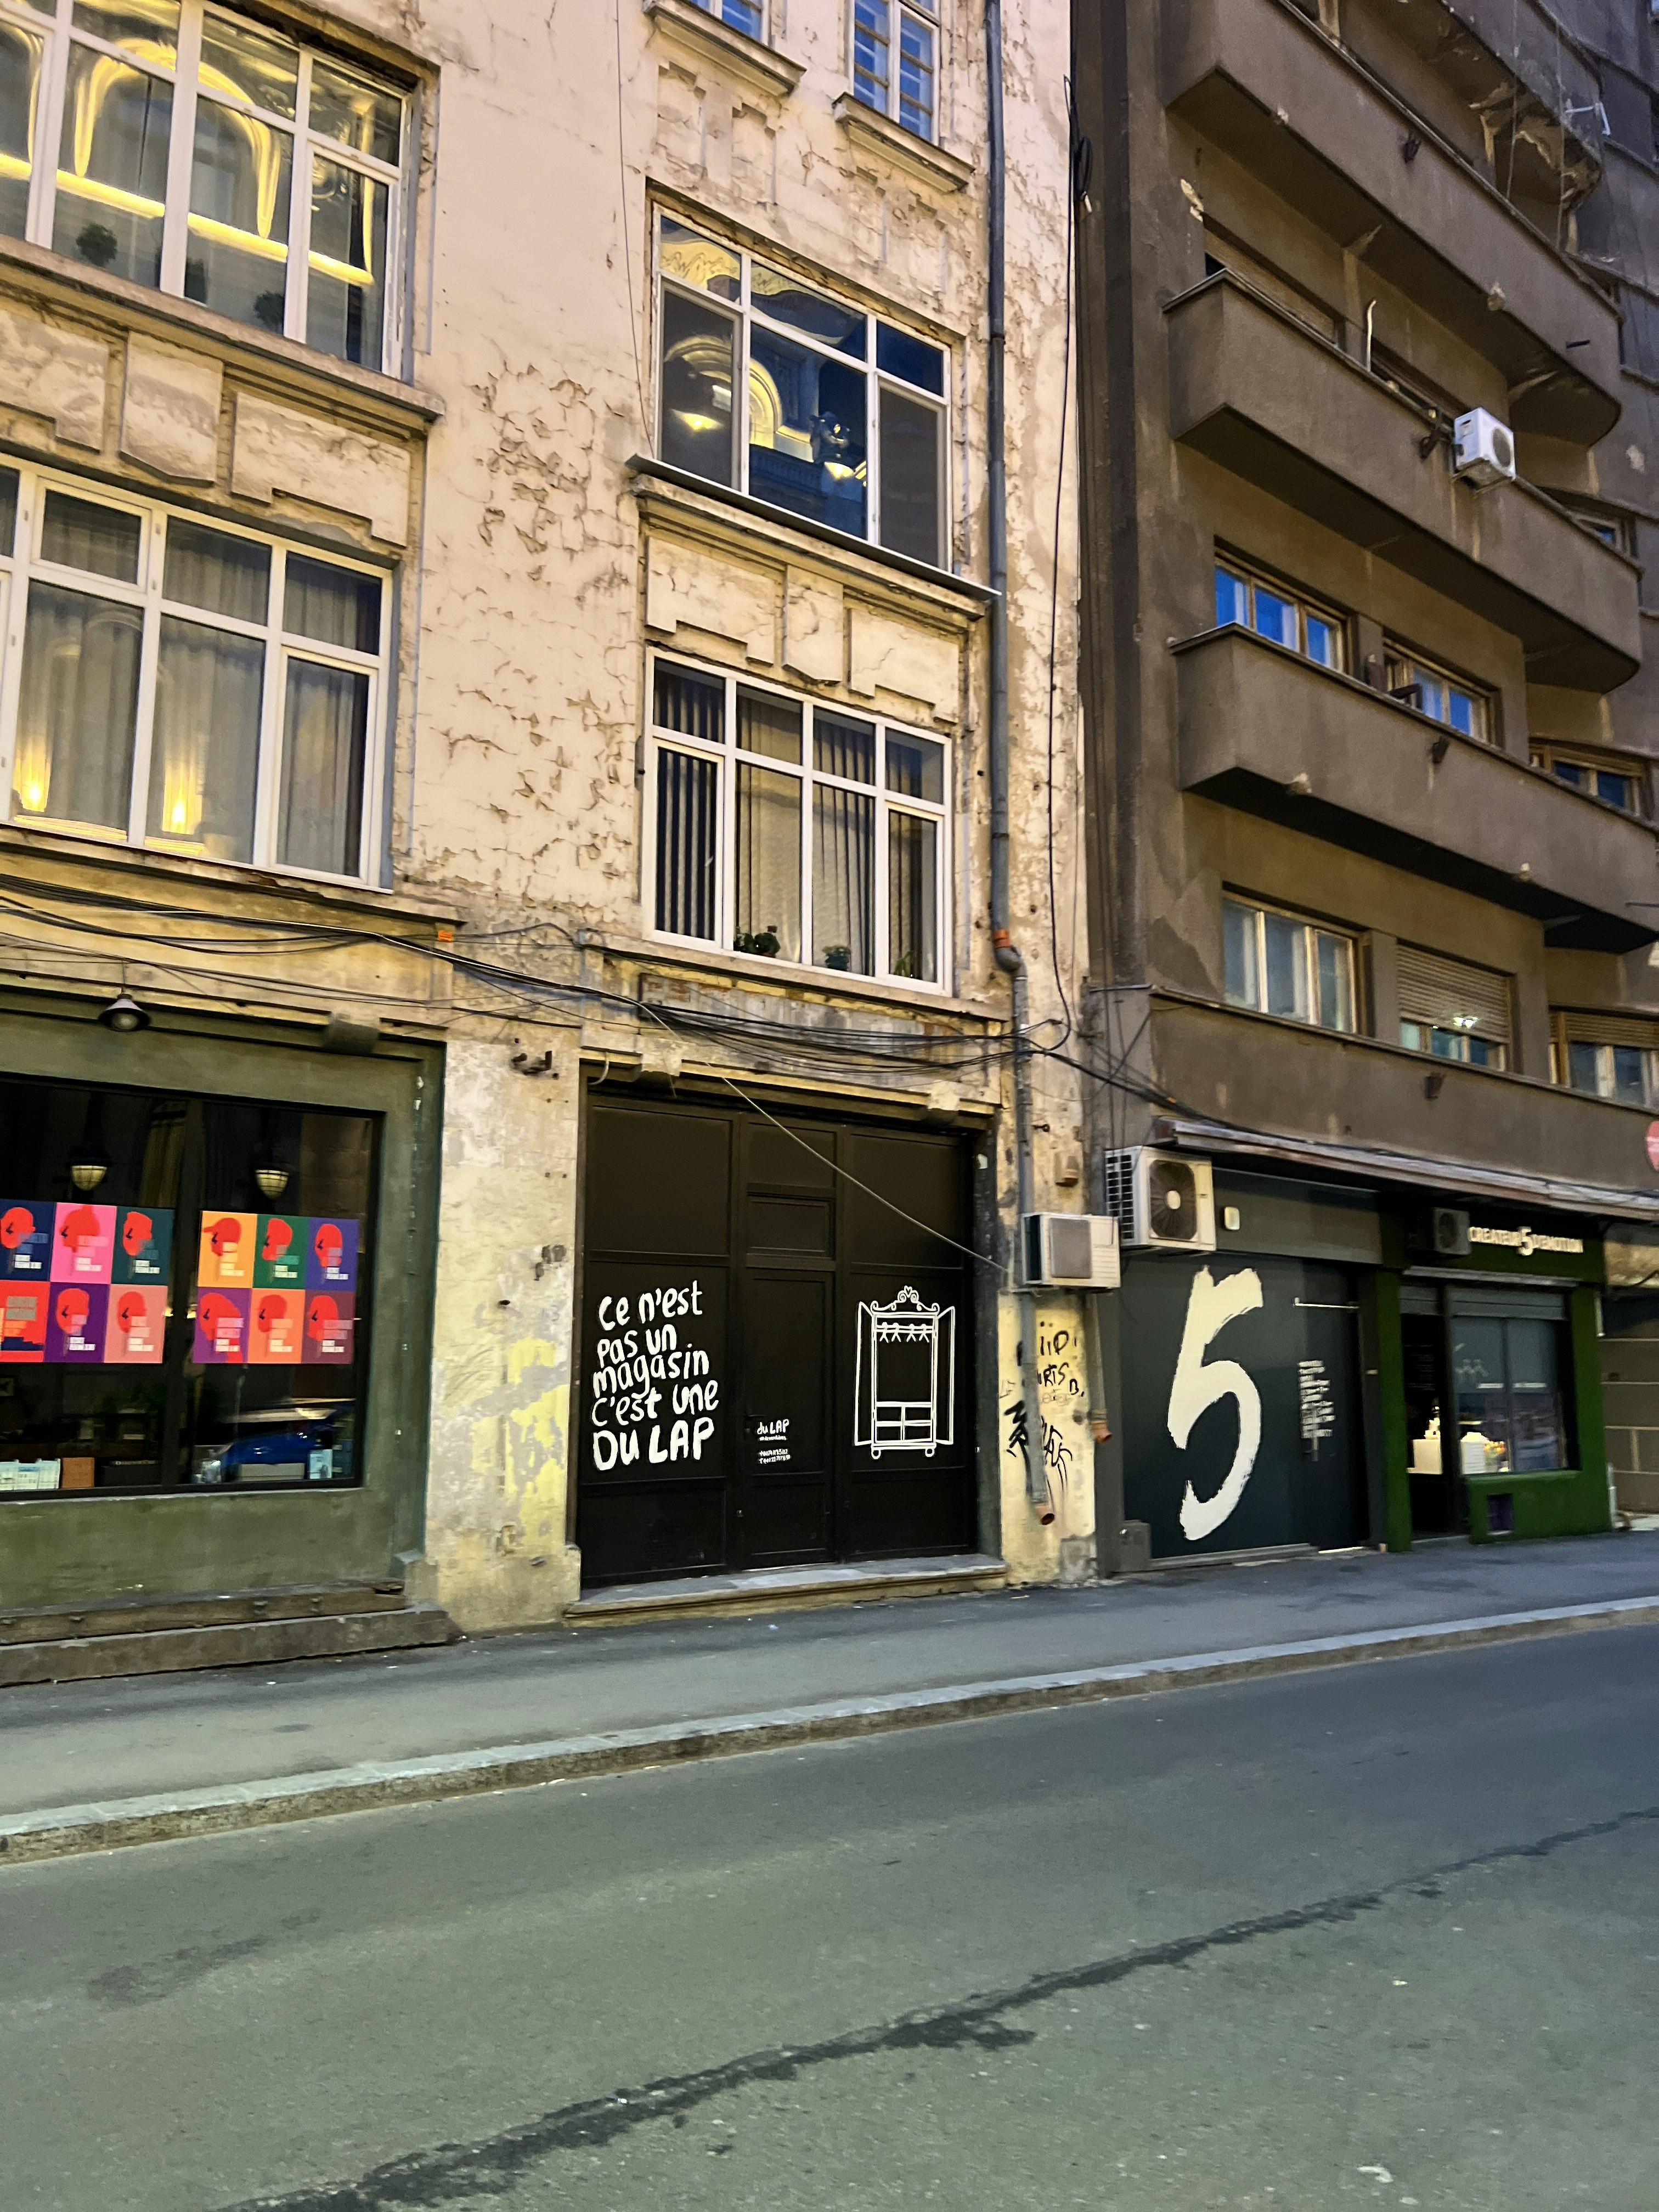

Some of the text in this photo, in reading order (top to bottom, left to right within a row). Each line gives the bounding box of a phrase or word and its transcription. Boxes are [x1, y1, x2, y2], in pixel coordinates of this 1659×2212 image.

[639, 1280, 703, 1323] n'est
[646, 1324, 677, 1355] un
[592, 1344, 709, 1400] magasin
[673, 1380, 719, 1415] une
[1167, 1265, 1263, 1541] 5
[649, 1417, 715, 1464] LAP
[757, 1419, 789, 1435] du LAP
